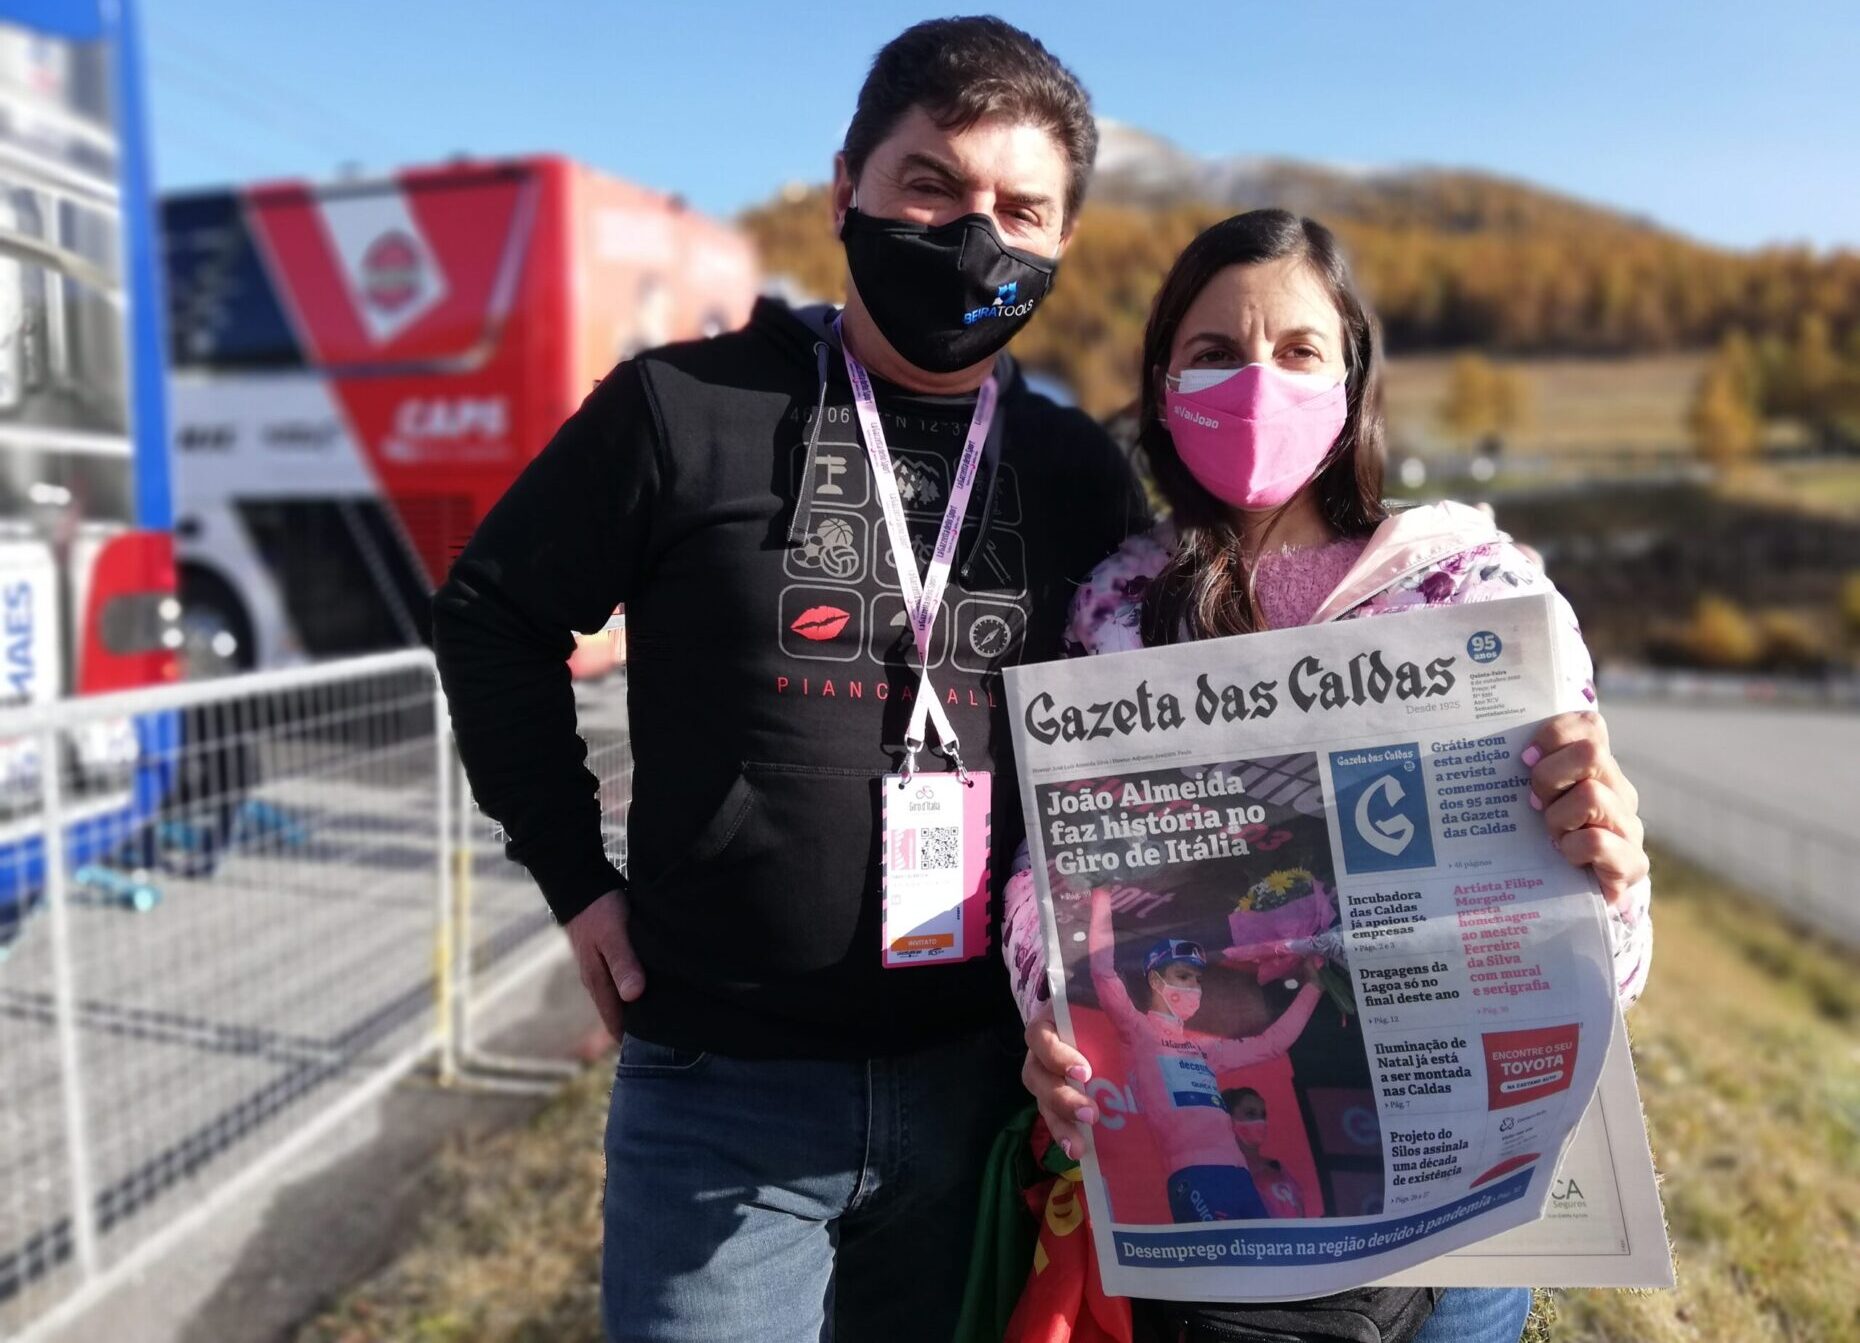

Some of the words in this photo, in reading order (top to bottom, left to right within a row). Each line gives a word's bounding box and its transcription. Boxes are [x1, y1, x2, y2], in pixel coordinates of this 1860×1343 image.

[963, 299, 1034, 324] BEIRATOOLS
[1470, 634, 1497, 652] 95
[1474, 651, 1498, 660] anos
[1025, 680, 1186, 745] Gazeta
[1195, 674, 1279, 726] das
[1288, 650, 1456, 713] Caldas
[1406, 702, 1436, 714] Desde
[1431, 738, 1476, 753] Grátis
[1477, 736, 1506, 748] com
[1337, 754, 1366, 766] Gazeta
[1368, 753, 1384, 762] das
[1384, 749, 1414, 760] Caldas
[1433, 755, 1463, 768] esta
[1465, 749, 1510, 764] edição
[1435, 772, 1444, 782] a
[1446, 766, 1496, 780] revista
[1046, 786, 1114, 816] João
[1119, 772, 1245, 808] Almeida
[1437, 775, 1532, 796] comemorativ
[1440, 799, 1464, 810] dos
[1466, 797, 1482, 809] 95
[1485, 793, 1518, 805] anos
[1050, 820, 1098, 846] faz
[1101, 803, 1222, 840] história
[1226, 804, 1266, 826] no
[1441, 813, 1458, 824] da
[1460, 809, 1510, 822] Gazeta
[1443, 828, 1468, 839] das
[1470, 822, 1517, 836] Caldas
[1055, 848, 1120, 876] Giro
[1125, 842, 1161, 868] de
[1164, 832, 1250, 864] Itália
[1454, 881, 1502, 896] Artista
[1504, 877, 1544, 890] Filipa
[1347, 890, 1422, 906] Incubadora
[1456, 892, 1516, 906] Morgado
[1349, 908, 1372, 918] das
[1374, 903, 1418, 916] Caldas
[1456, 905, 1502, 918] presta
[1458, 910, 1541, 928] homenagem
[1350, 919, 1363, 931] já
[1365, 916, 1410, 928] apoiou
[1411, 914, 1428, 923] 54
[1352, 926, 1415, 940] empresas
[1462, 930, 1478, 942] ao
[1480, 925, 1529, 939] mestre
[1464, 940, 1521, 955] Ferreira
[1467, 957, 1486, 968] da
[1486, 954, 1522, 967] Silva
[1358, 964, 1430, 980] Dragagens
[1431, 961, 1448, 972] da
[1470, 971, 1498, 982] com
[1500, 964, 1542, 980] mural
[1362, 982, 1402, 994] Lagoa
[1404, 978, 1420, 989] só
[1421, 978, 1438, 988] no
[1472, 986, 1480, 996] e
[1482, 979, 1552, 996] serigrafia
[1365, 994, 1396, 1007] final
[1396, 992, 1433, 1004] deste
[1435, 990, 1460, 1000] ano
[1374, 1039, 1448, 1055] Iluminação
[1450, 1036, 1468, 1048] de
[1492, 1046, 1544, 1061] ENCONTRE
[1545, 1044, 1553, 1054] O
[1554, 1041, 1573, 1052] SEU
[1376, 1055, 1415, 1069] Natal
[1415, 1054, 1429, 1069] já
[1430, 1052, 1460, 1064] está
[1501, 1054, 1564, 1077] TOYOTA
[1380, 1074, 1389, 1083] a
[1390, 1072, 1412, 1082] ser
[1414, 1066, 1472, 1080] montada
[1382, 1087, 1406, 1098] nas
[1408, 1082, 1452, 1096] Caldas
[1390, 1130, 1436, 1144] Projeto
[1438, 1128, 1453, 1140] do
[1392, 1145, 1421, 1158] Silos
[1423, 1140, 1470, 1156] assinala
[1392, 1162, 1418, 1172] uma
[1419, 1154, 1458, 1170] década
[1392, 1175, 1406, 1186] de
[1408, 1166, 1462, 1184] existência
[1552, 1200, 1587, 1210] Seguros
[1122, 1242, 1226, 1262] Desemprego
[1230, 1239, 1292, 1260] dispara
[1296, 1242, 1316, 1255] na
[1318, 1234, 1366, 1257] região
[1368, 1224, 1414, 1248] devido
[1415, 1220, 1424, 1234] à
[1424, 1194, 1492, 1234] pandemia
